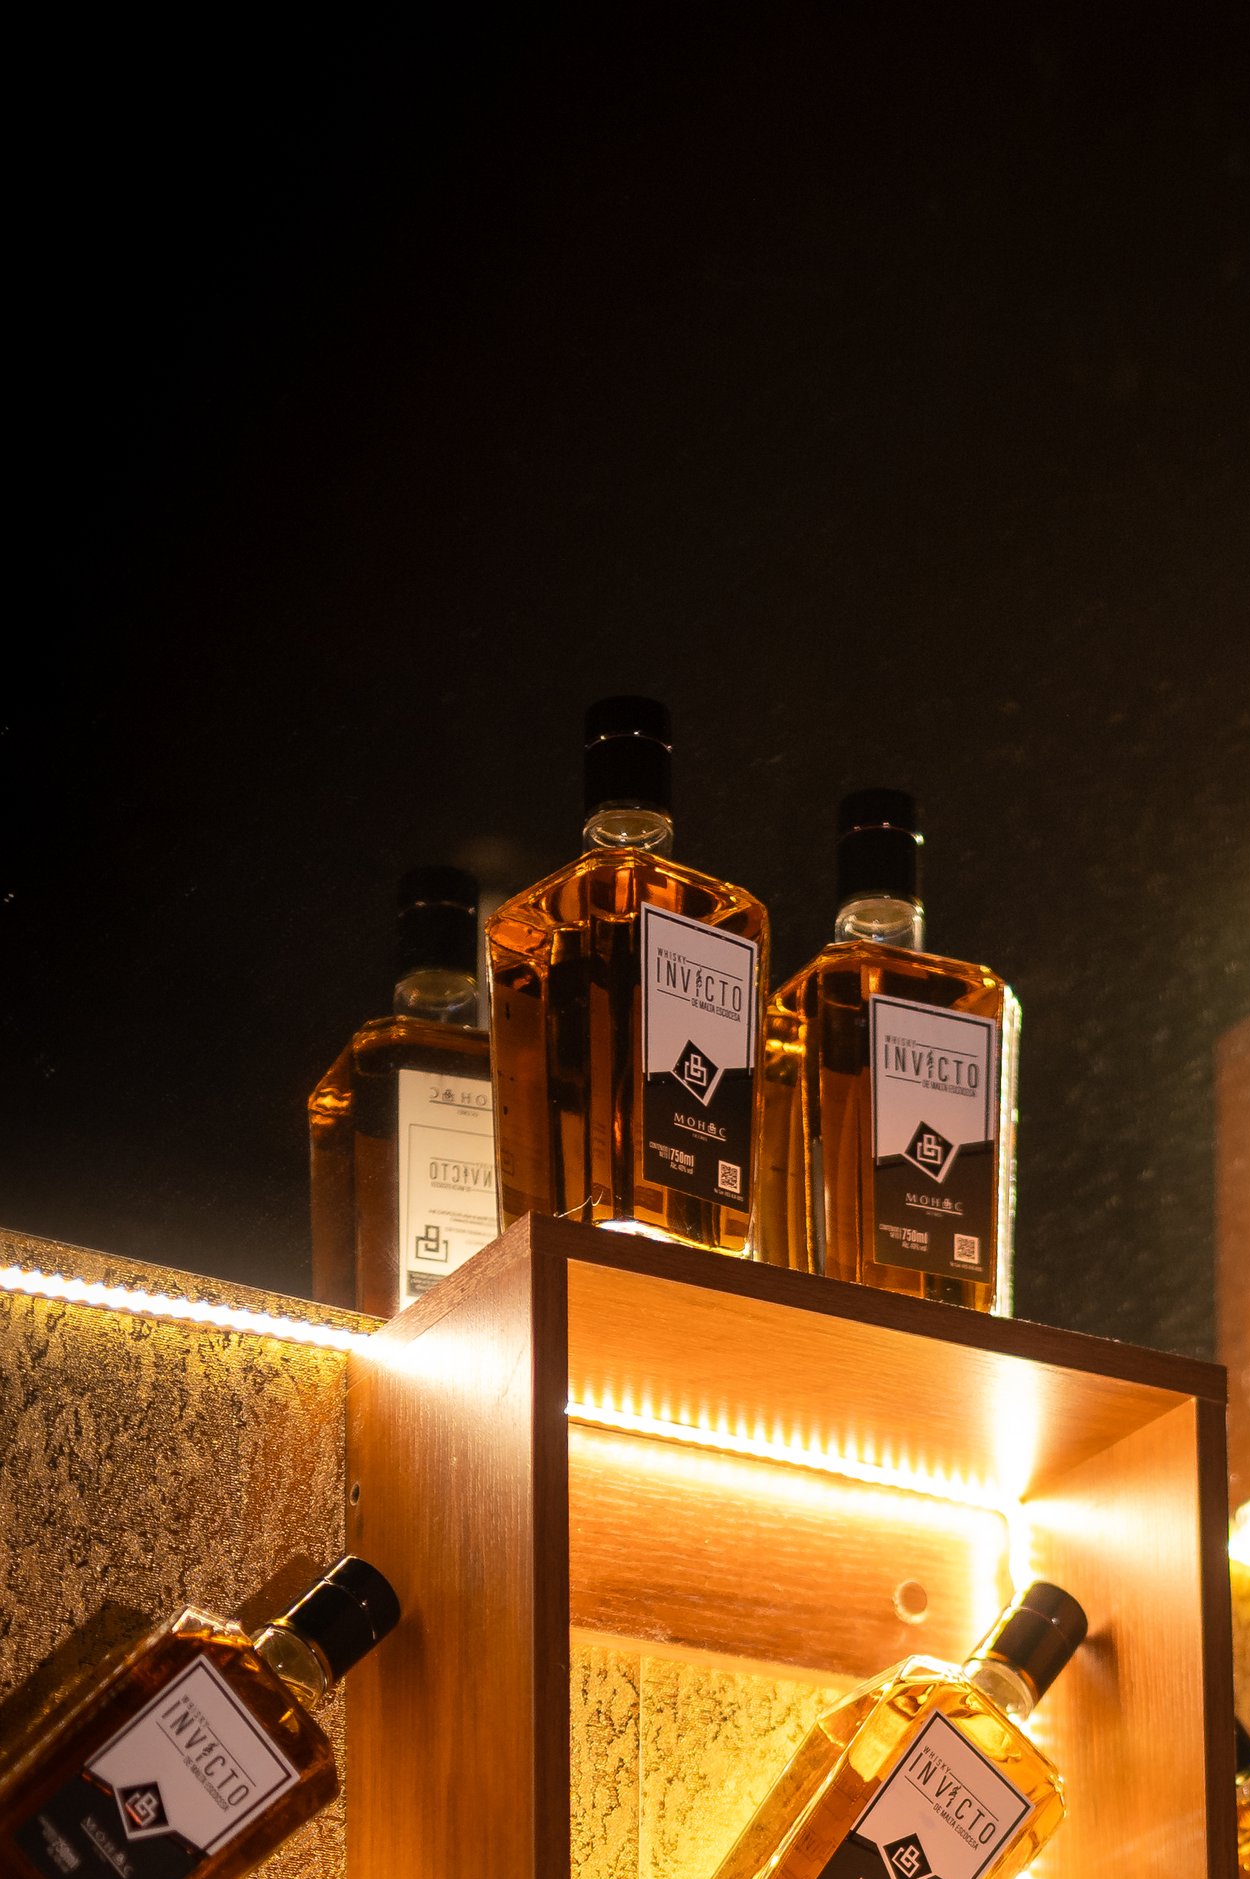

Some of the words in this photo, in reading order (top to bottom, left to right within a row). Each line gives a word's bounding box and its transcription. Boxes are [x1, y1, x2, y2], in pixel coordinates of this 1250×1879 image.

[657, 947, 687, 963] WHISKY
[656, 957, 743, 1012] INVICTO
[691, 998, 699, 1008] DE
[699, 1001, 716, 1014] MALTA
[716, 1006, 741, 1022] ESCOCESA
[885, 1044, 979, 1089] INVICTO
[670, 1148, 695, 1167] 750ml
[161, 1700, 250, 1806] INVICTO
[922, 1745, 952, 1774] WHISKY
[908, 1752, 996, 1845] INVICTO
[933, 1803, 943, 1814] DE
[940, 1810, 957, 1827] MALTA
[954, 1823, 980, 1850] ESCOCESA
